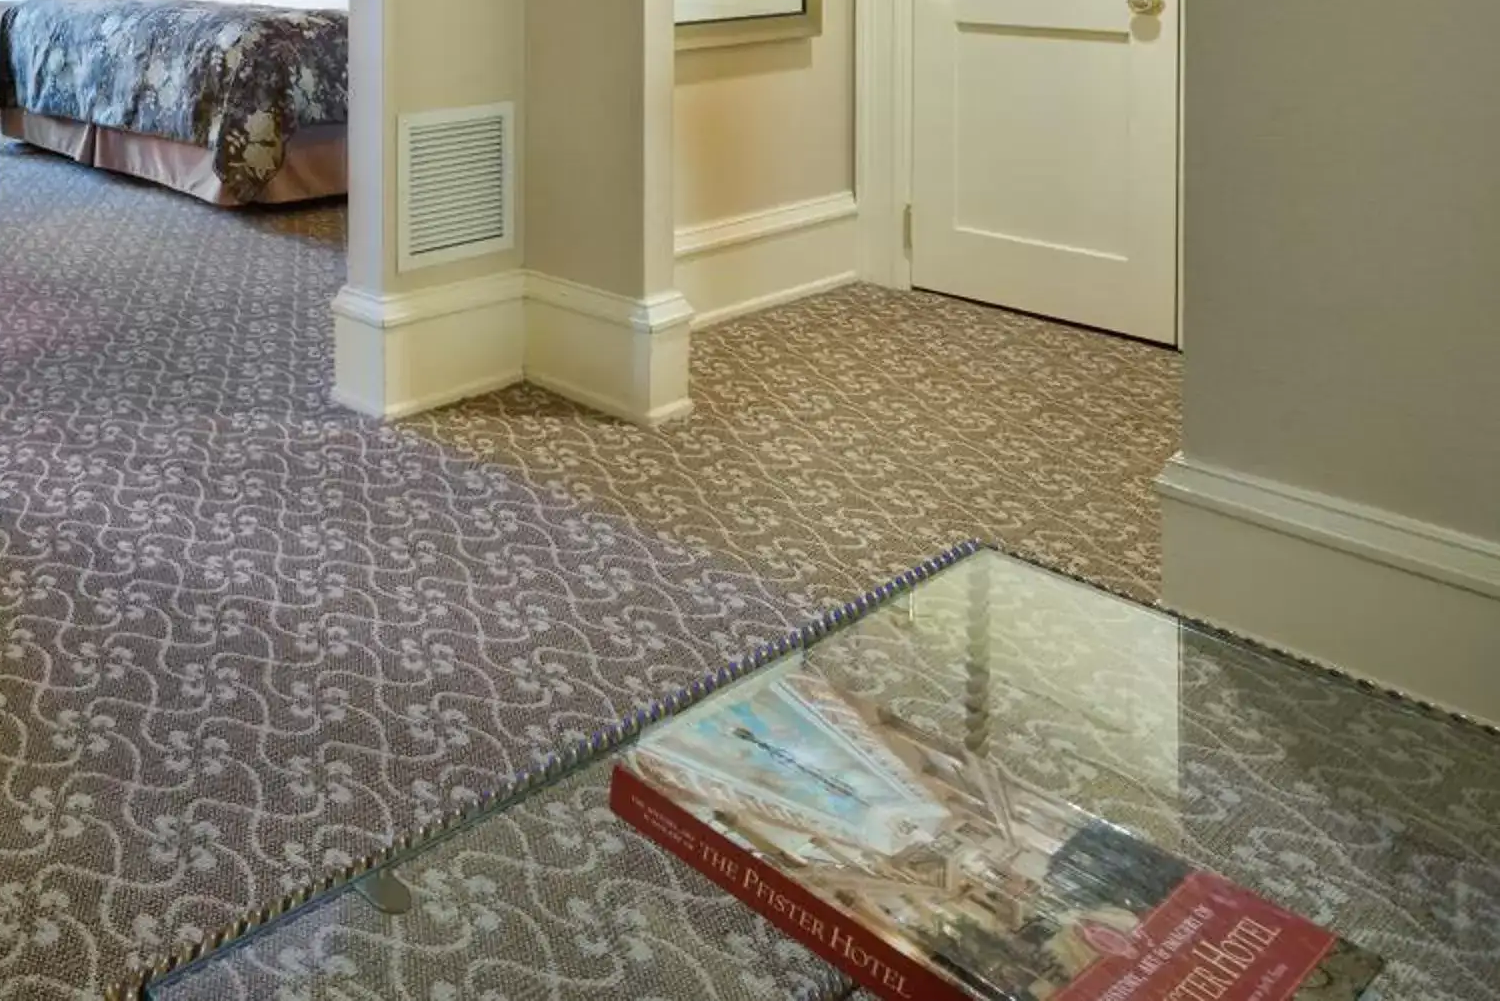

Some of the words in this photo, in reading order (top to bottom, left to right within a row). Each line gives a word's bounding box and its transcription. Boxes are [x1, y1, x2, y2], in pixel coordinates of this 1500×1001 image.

[701, 843, 739, 881] THE
[742, 868, 825, 943] PFISTER
[831, 926, 912, 999] HOTEL
[1192, 916, 1281, 979] HOTEL
